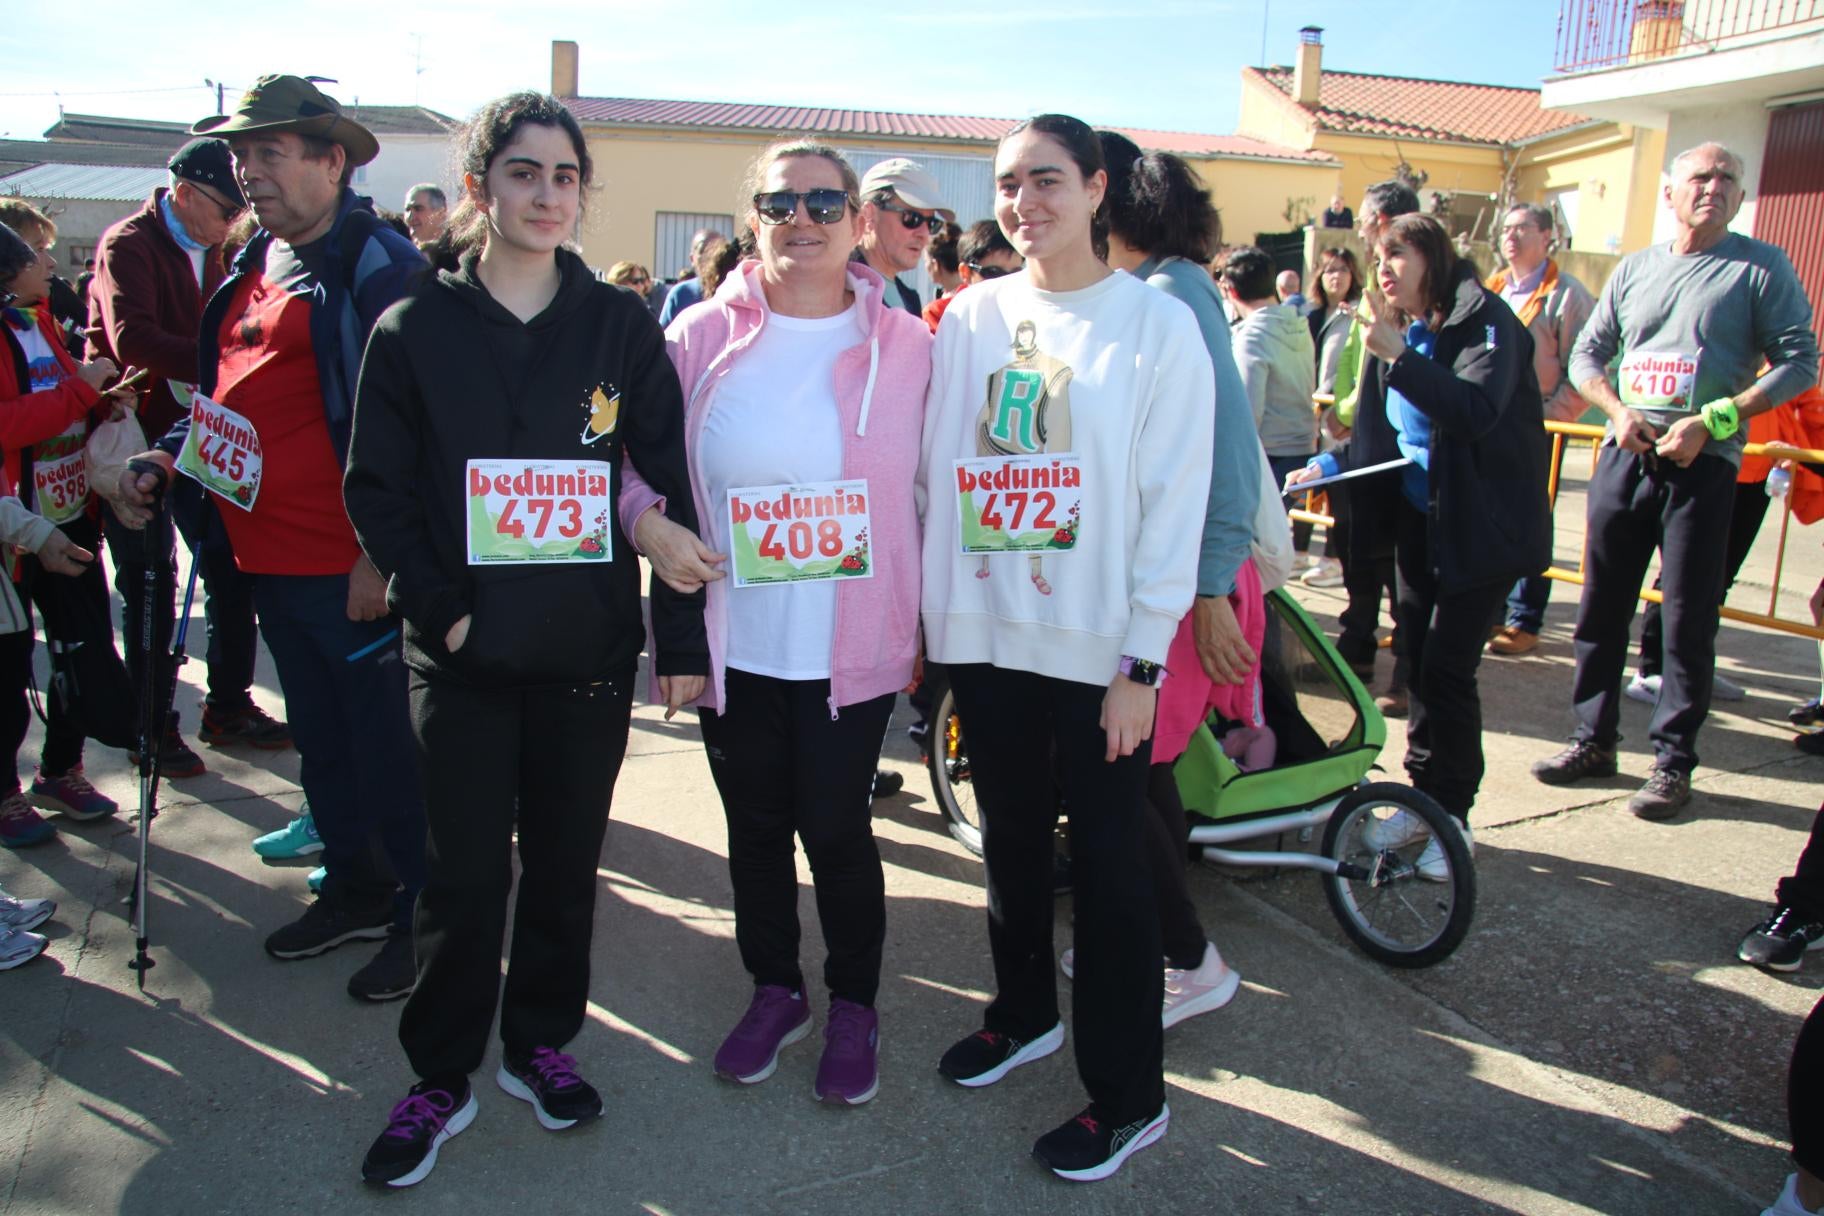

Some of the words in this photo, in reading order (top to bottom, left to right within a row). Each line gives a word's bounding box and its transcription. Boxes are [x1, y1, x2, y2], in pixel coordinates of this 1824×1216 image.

[1622, 358, 1694, 374] edunia
[1631, 374, 1676, 396] 410
[193, 400, 261, 458] bedunia
[990, 369, 1039, 452] R
[198, 434, 247, 481] 445
[52, 474, 86, 509] 398
[470, 469, 607, 496] bedunia
[957, 461, 1080, 493] bedunia
[496, 498, 583, 539] 473
[731, 489, 866, 524] bedunia
[980, 491, 1056, 530] 472
[758, 519, 843, 561] 408
